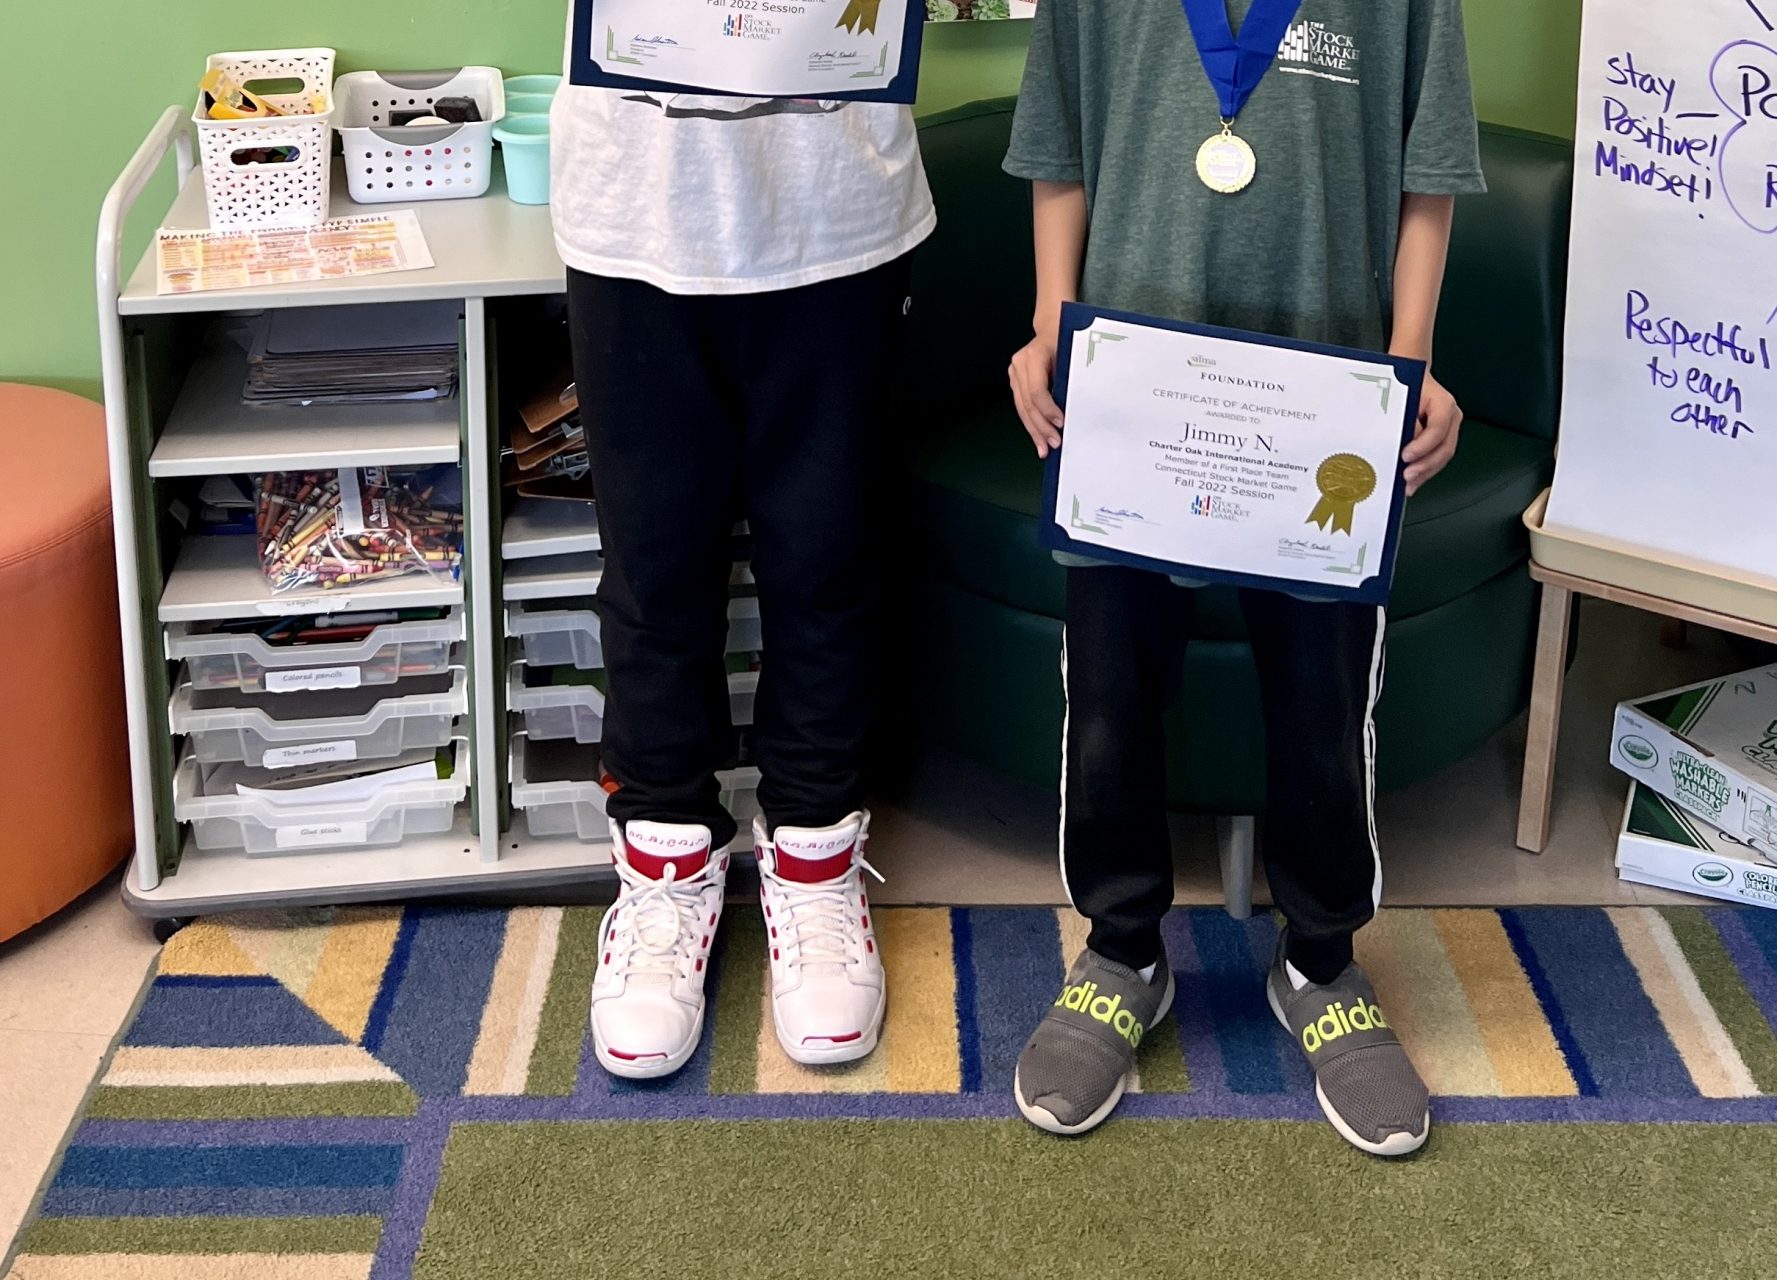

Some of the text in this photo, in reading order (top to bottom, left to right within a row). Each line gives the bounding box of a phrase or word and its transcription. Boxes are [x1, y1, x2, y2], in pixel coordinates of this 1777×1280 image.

[730, 0, 757, 10] 2022
[762, 3, 805, 13] Session
[1309, 27, 1353, 47] STOCK
[1606, 52, 1675, 113] Stay
[1627, 290, 1770, 369] Respectful
[1647, 357, 1741, 413] to each
[1179, 422, 1278, 453] Jimmy N.
[1671, 403, 1754, 438] other
[283, 671, 342, 681] Colored pencils
[1669, 757, 1730, 804] WASHABLE
[1676, 751, 1726, 785] ULTRA-CLEAN
[1675, 775, 1721, 812] MARKERS
[1054, 980, 1144, 1048] adidas
